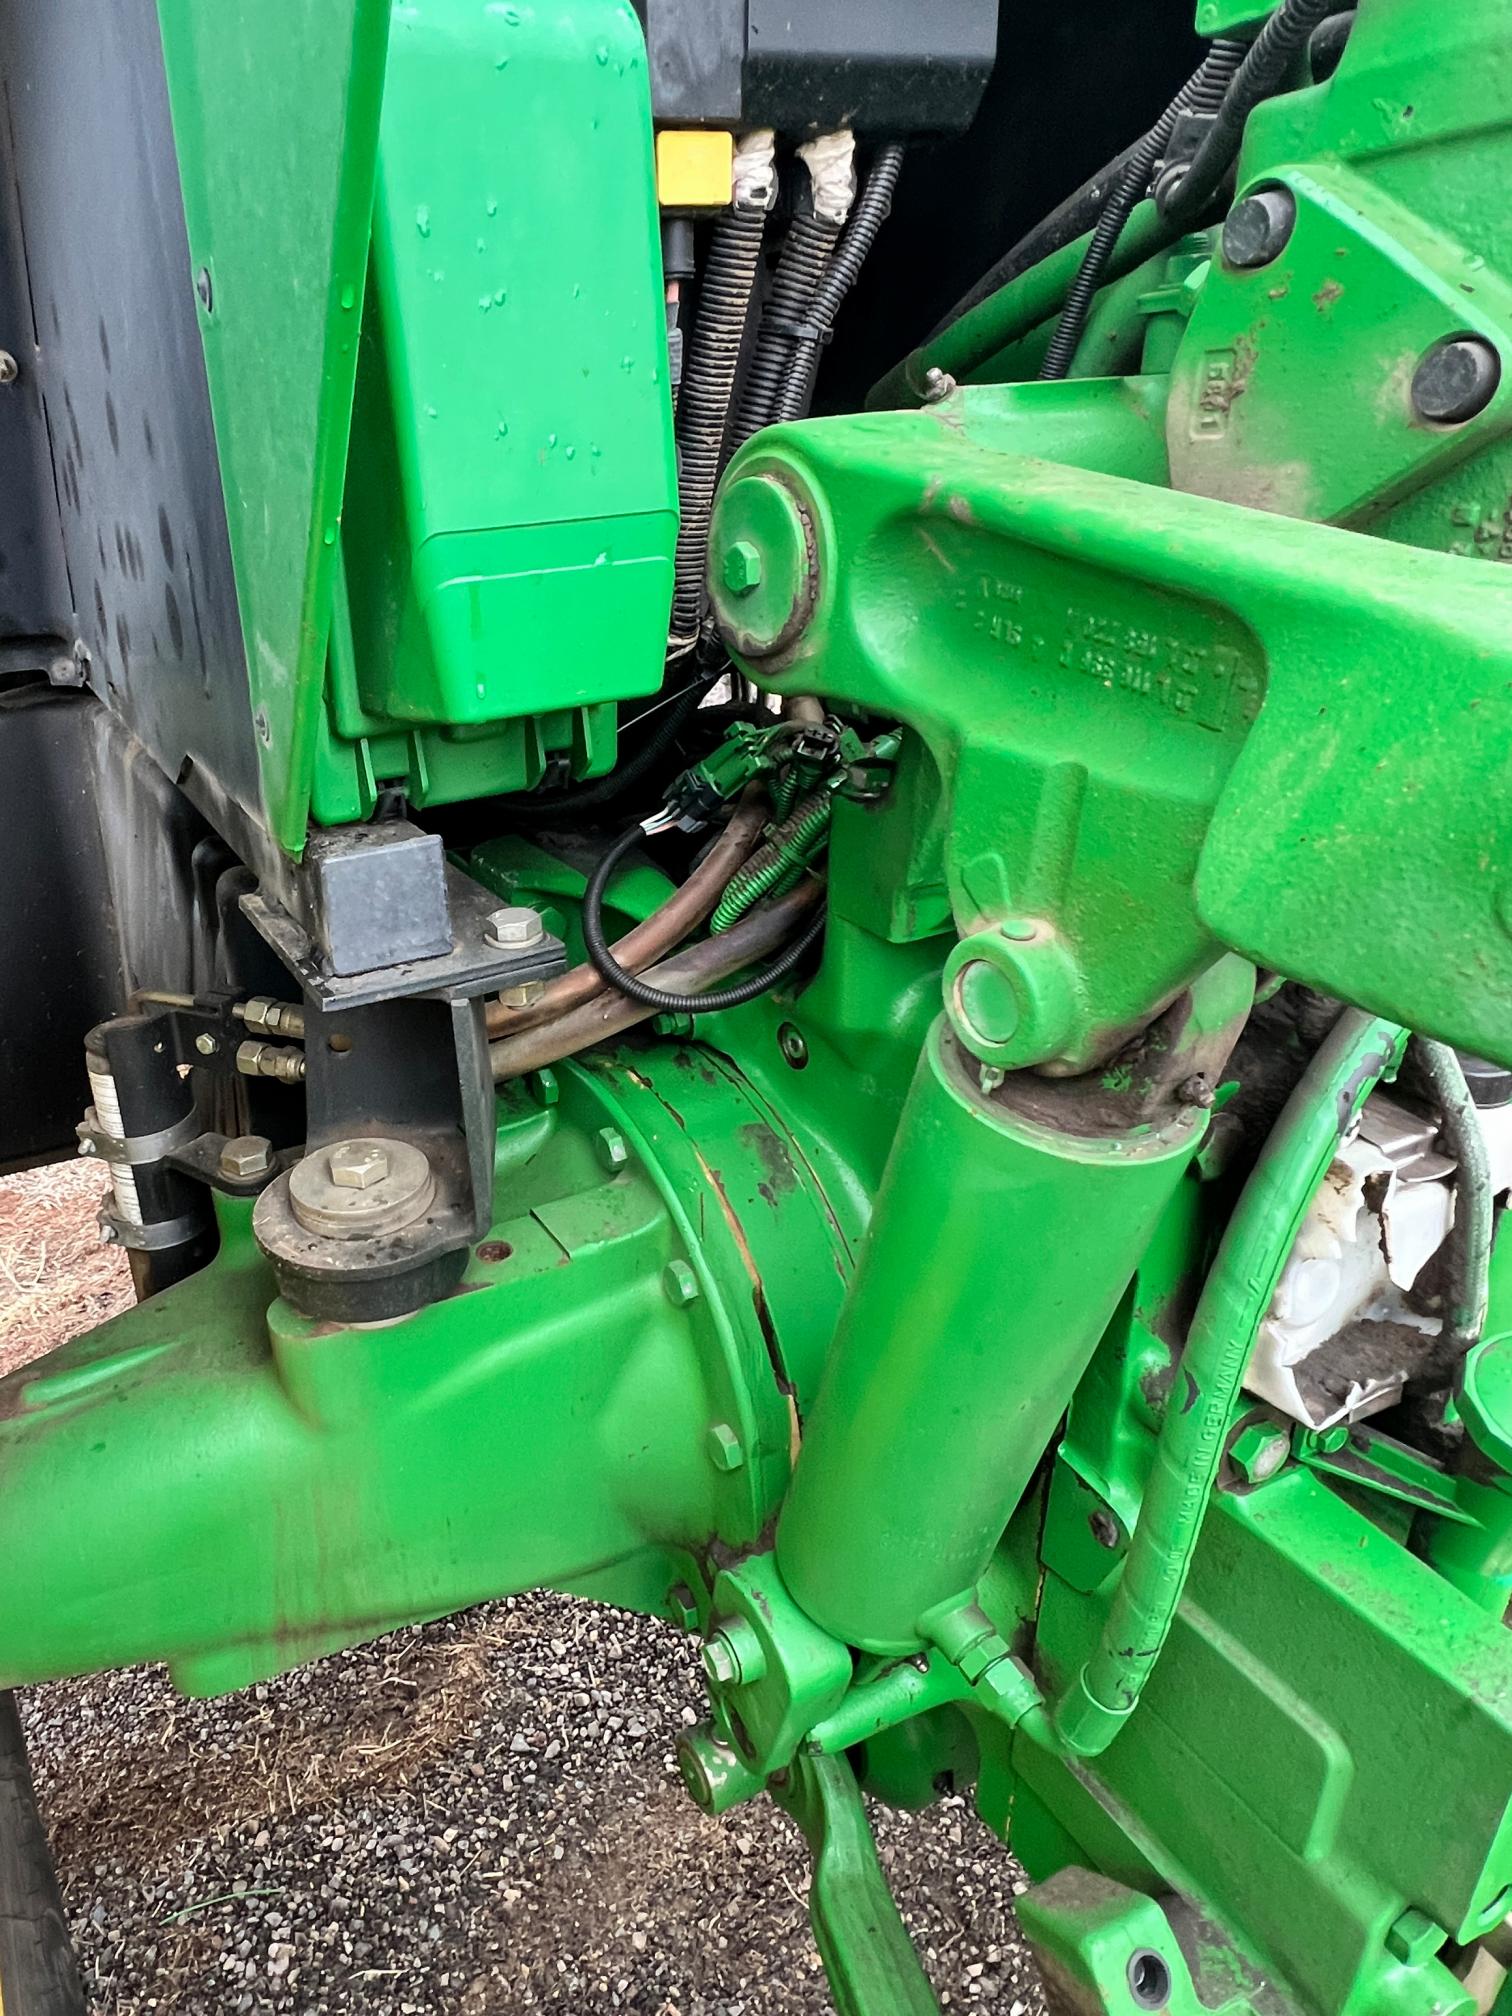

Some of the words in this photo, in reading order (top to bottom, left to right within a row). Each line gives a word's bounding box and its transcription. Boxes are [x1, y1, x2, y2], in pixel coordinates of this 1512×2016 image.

[1200, 1339, 1244, 1441] GERMANY
[1190, 1446, 1213, 1467] IN
[1177, 1470, 1205, 1525] MADE
